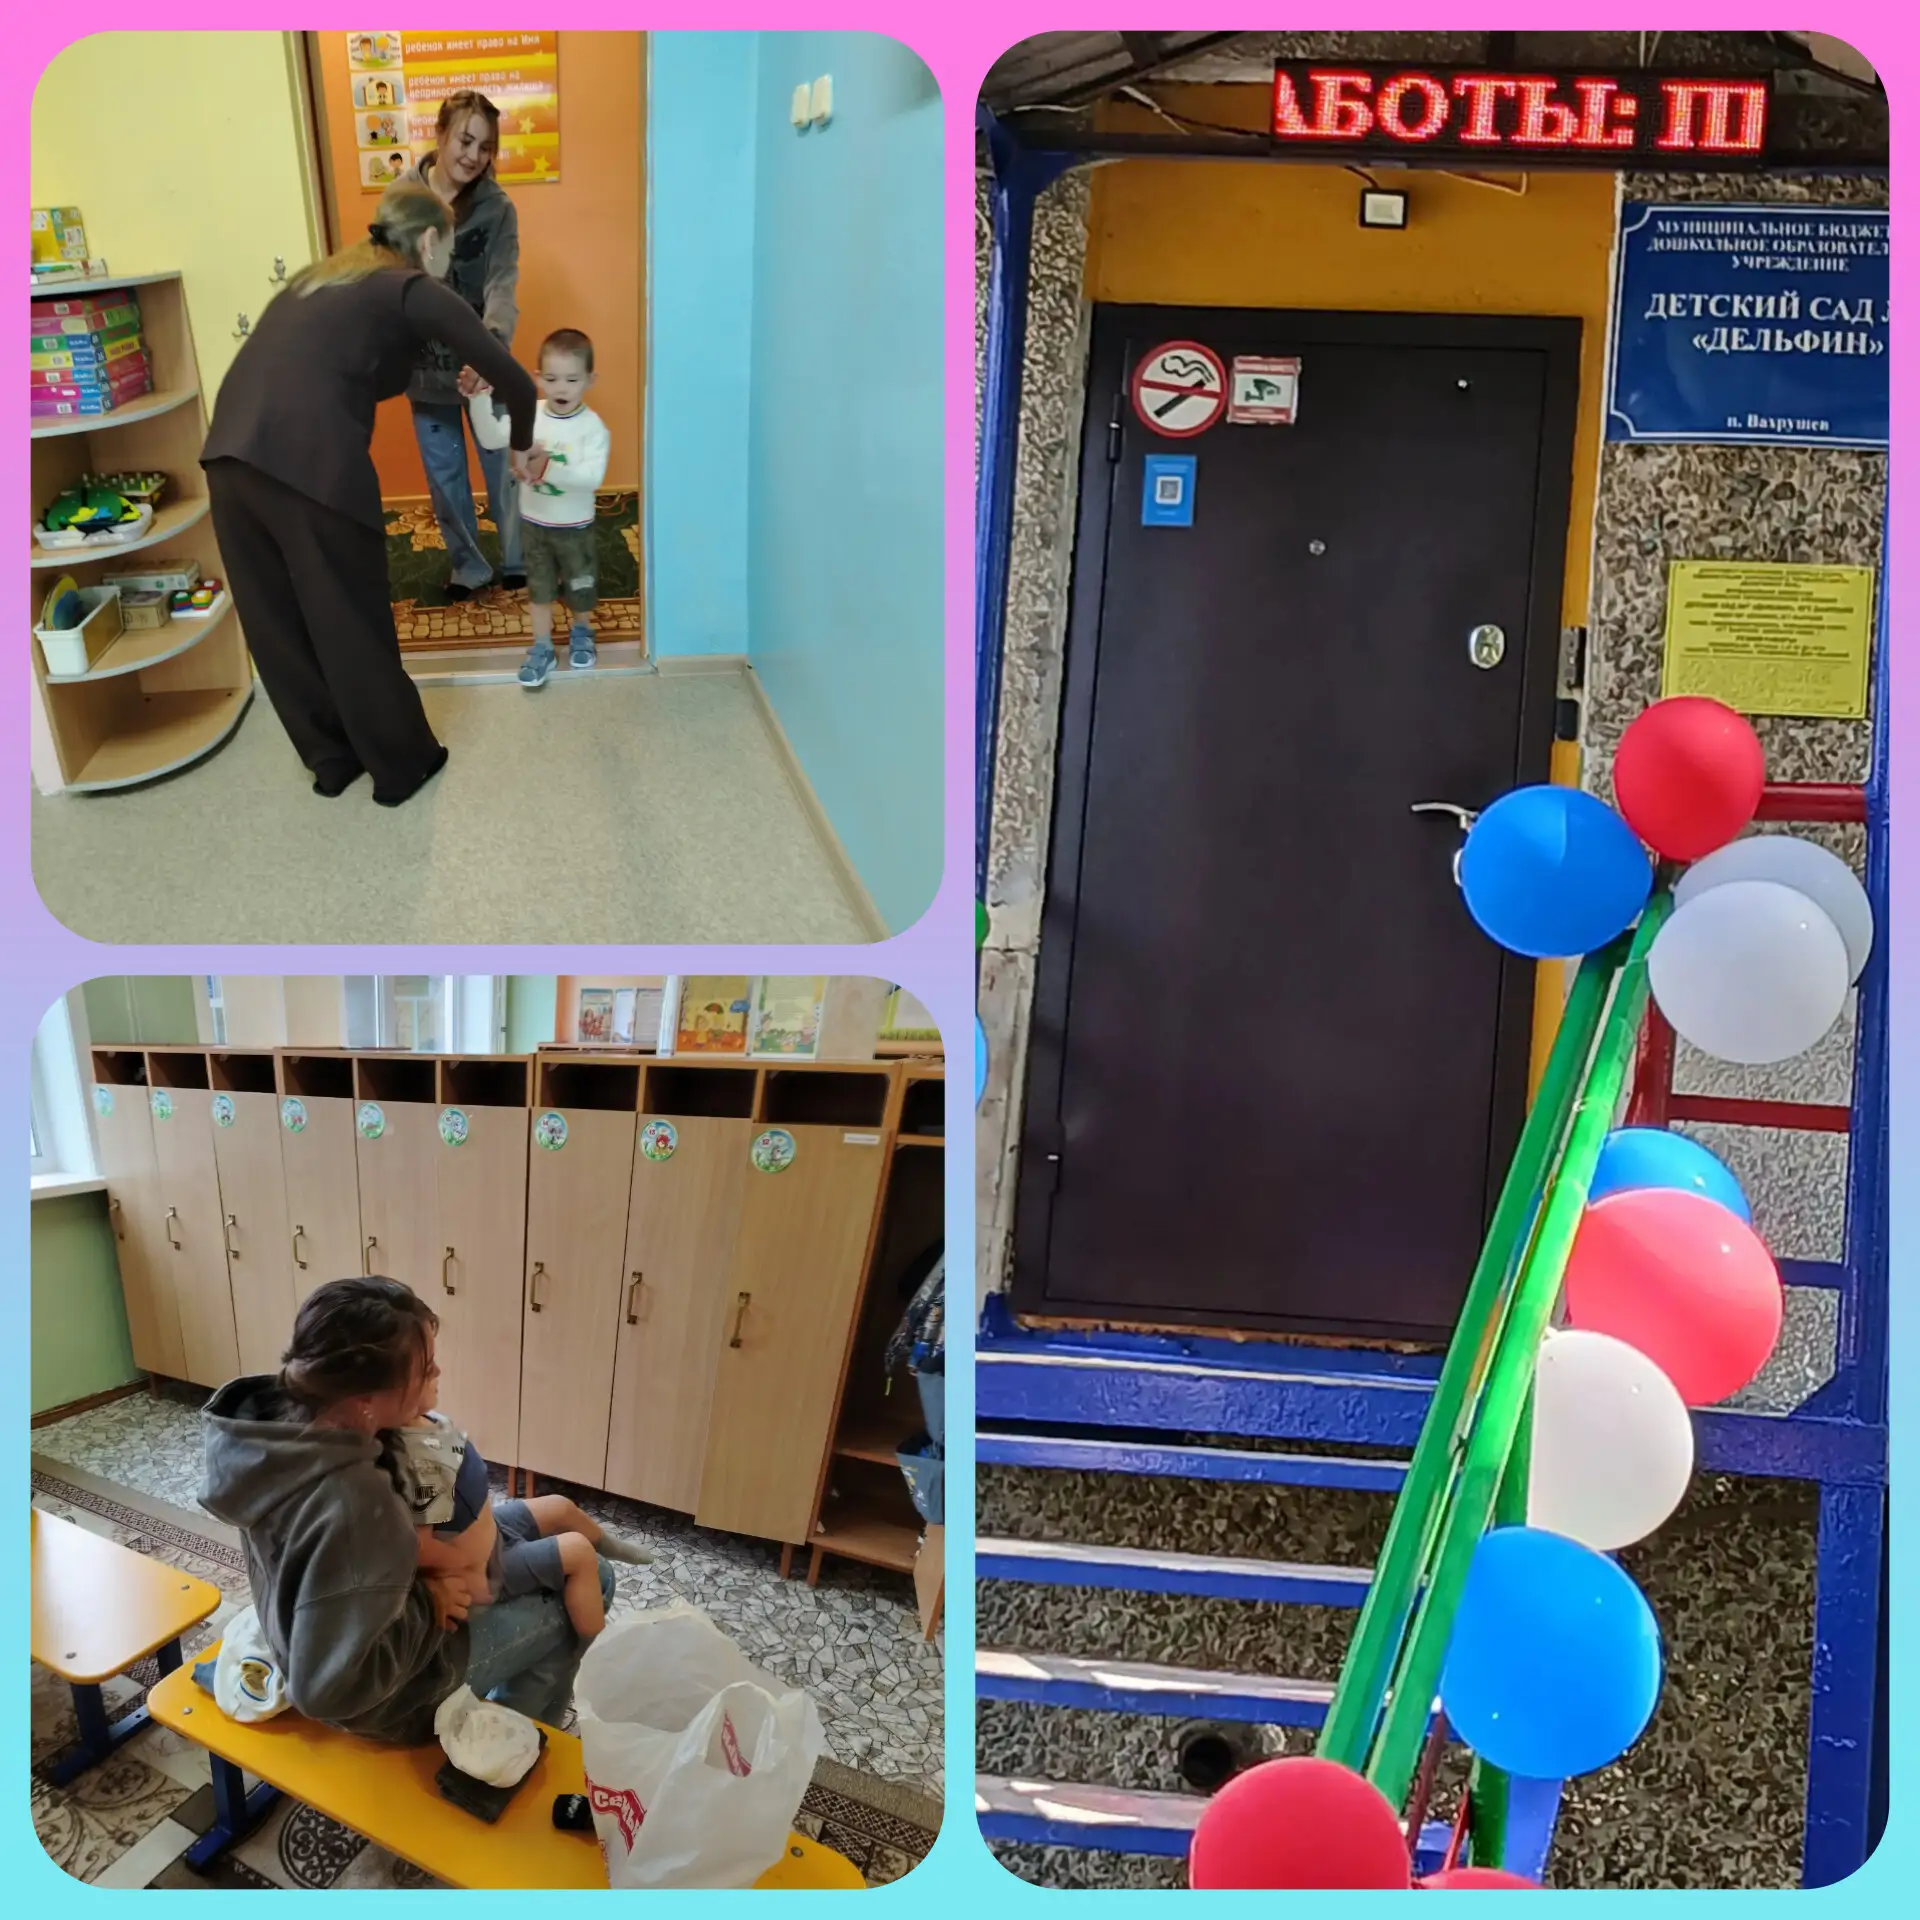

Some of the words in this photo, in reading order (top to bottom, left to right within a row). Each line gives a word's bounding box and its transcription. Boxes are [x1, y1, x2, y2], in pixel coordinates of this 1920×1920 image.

[1656, 220, 1815, 236] МУНИЦИПАЛЬНОЕ
[1647, 237, 1768, 252] ДОШКОЛЬНОЕ
[1732, 255, 1850, 272] УЧРЕЖДЕНИЕ
[1644, 290, 1800, 320] ДЕТСКИЙ
[1809, 297, 1875, 326] САД
[1692, 327, 1884, 355] «ДЕЛЬФИН»
[1727, 416, 1742, 428] п.
[593, 1789, 642, 1838] Семь
